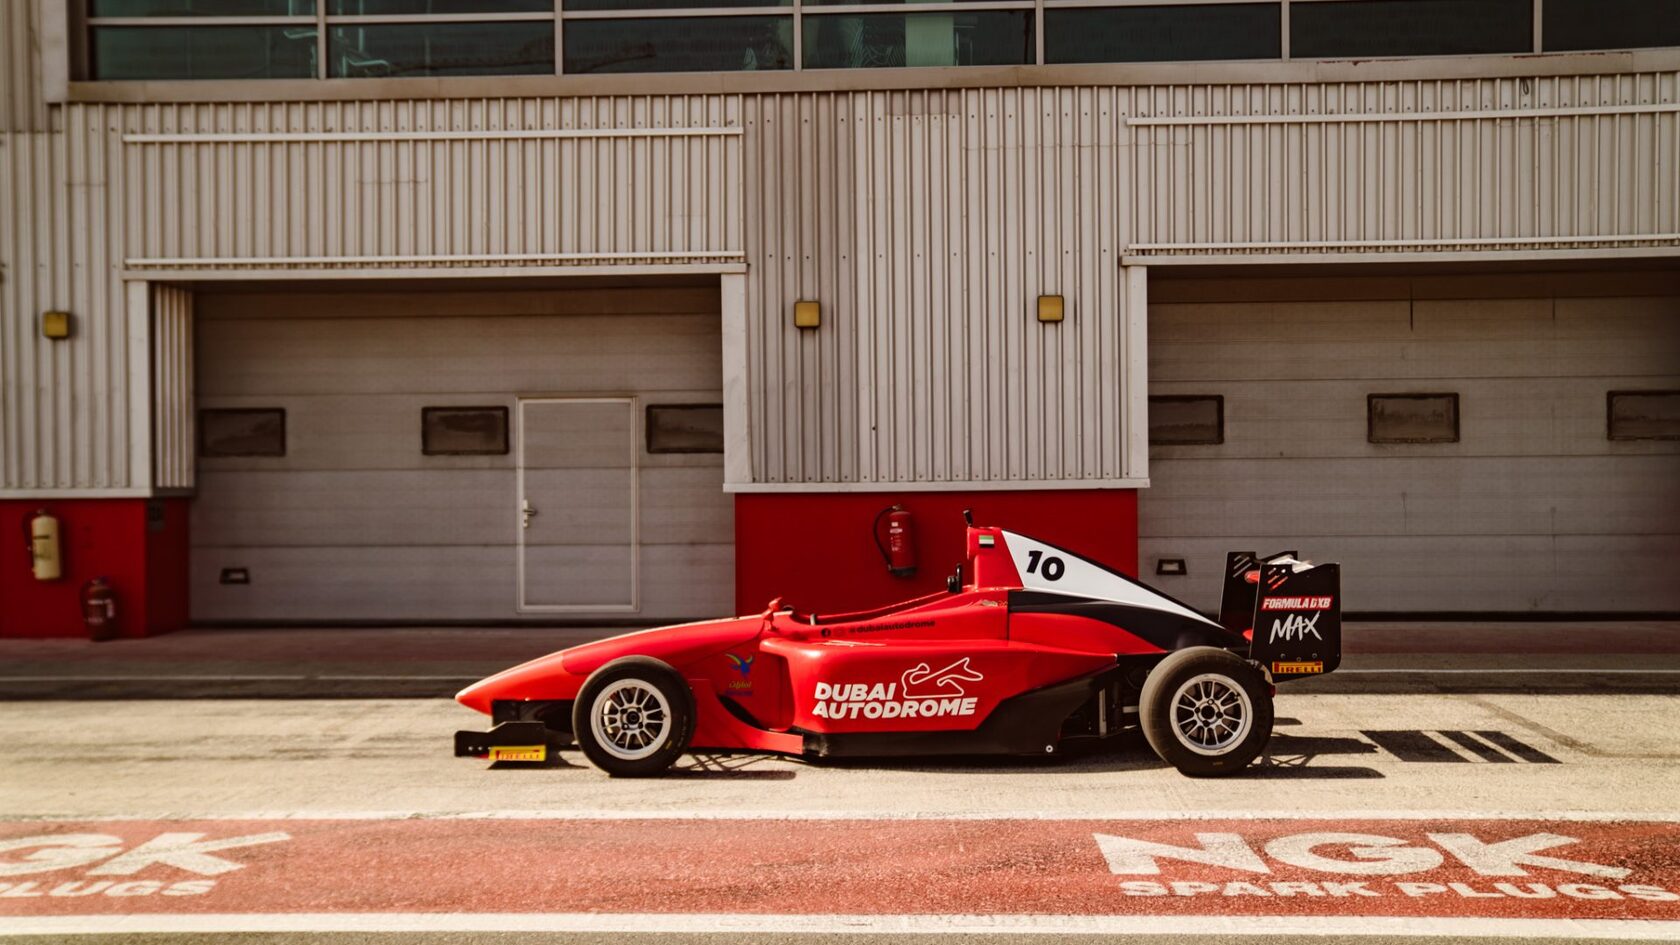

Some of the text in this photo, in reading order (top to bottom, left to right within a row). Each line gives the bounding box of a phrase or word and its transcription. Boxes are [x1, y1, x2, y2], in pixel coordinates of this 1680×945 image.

[1026, 551, 1065, 581] 10
[1269, 610, 1322, 644] MAX
[814, 682, 896, 701] DUBAI
[812, 698, 977, 719] AUTODROME
[1092, 832, 1632, 878] NGK
[1119, 881, 1680, 901] SPARK PLUGS
